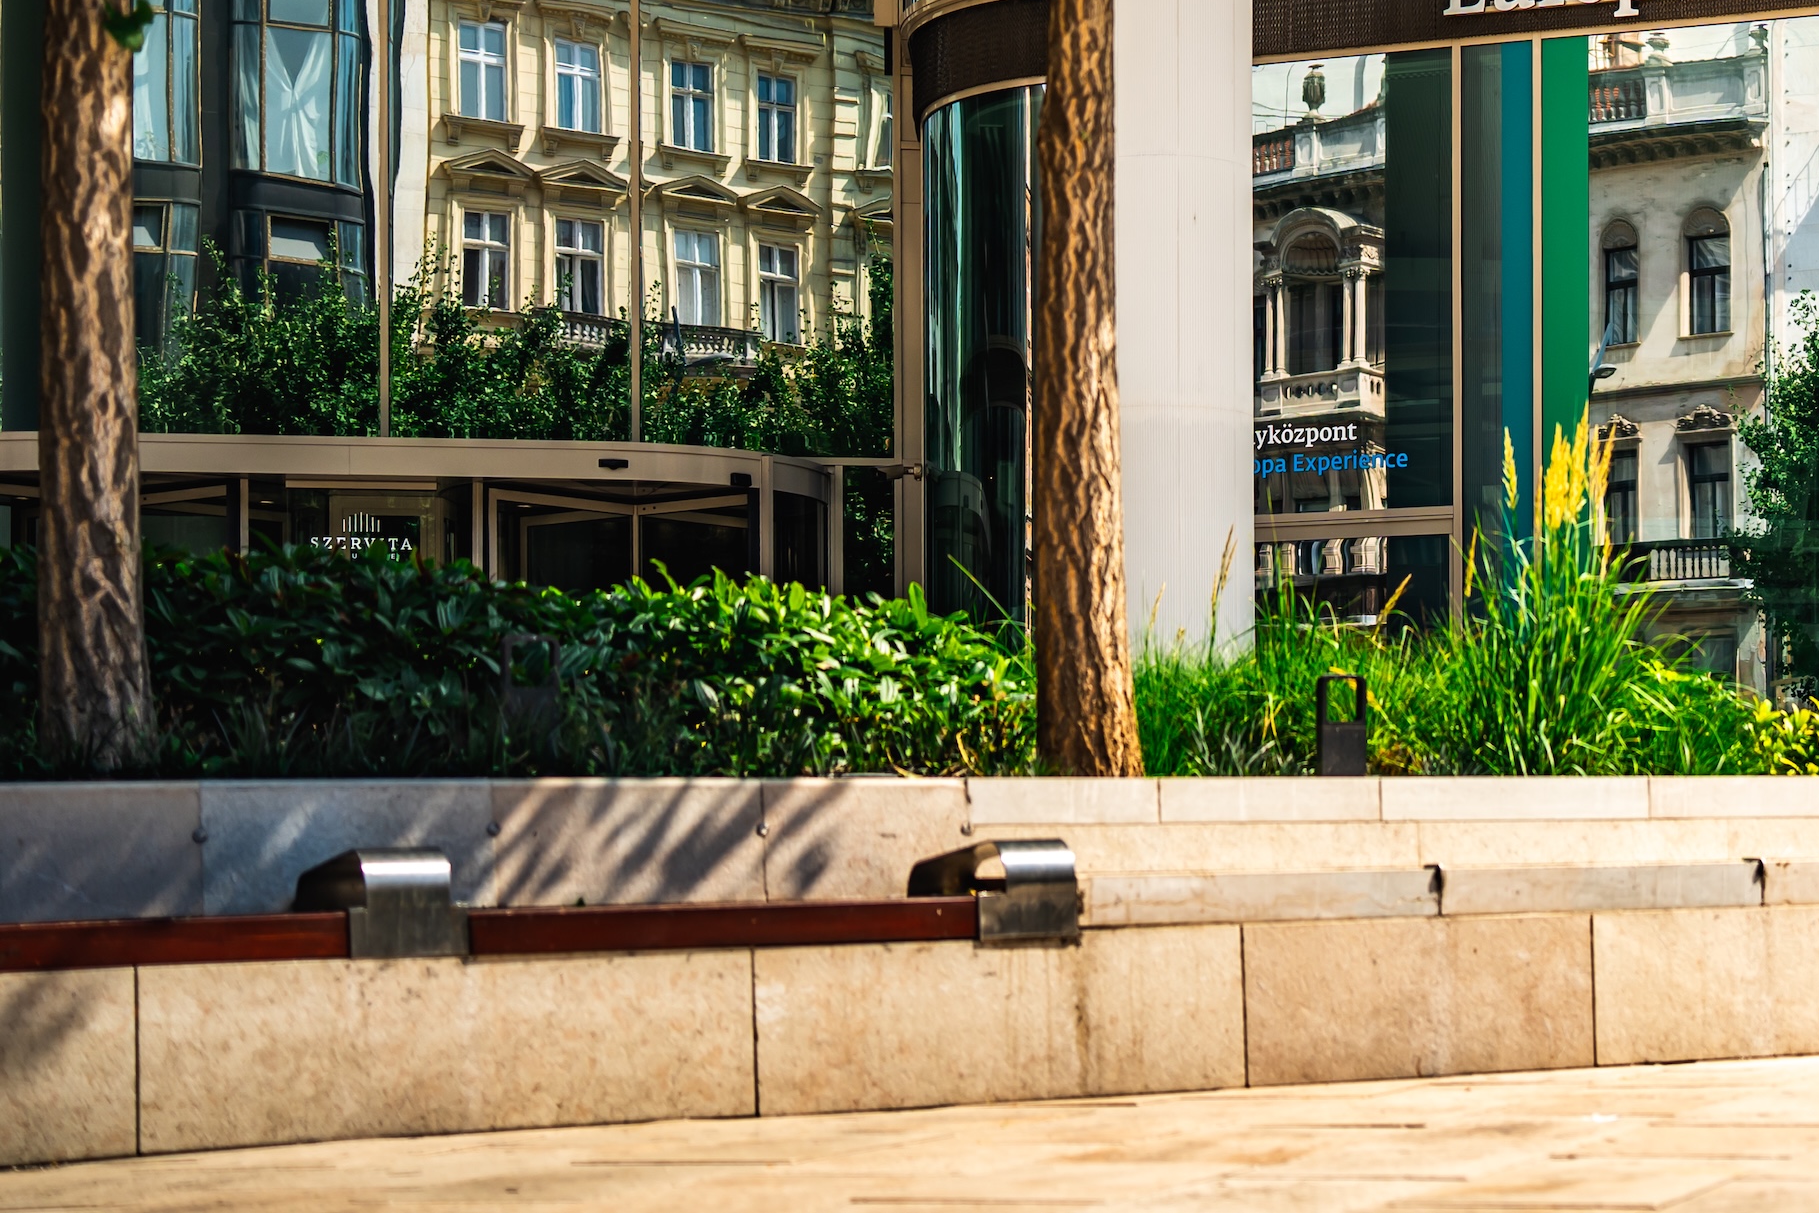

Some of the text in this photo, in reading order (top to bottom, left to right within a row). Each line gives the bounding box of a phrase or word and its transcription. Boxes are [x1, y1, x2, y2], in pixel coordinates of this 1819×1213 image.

[1253, 422, 1357, 450] yközpont
[1293, 449, 1409, 475] Experience
[310, 537, 412, 550] SZERVTA
